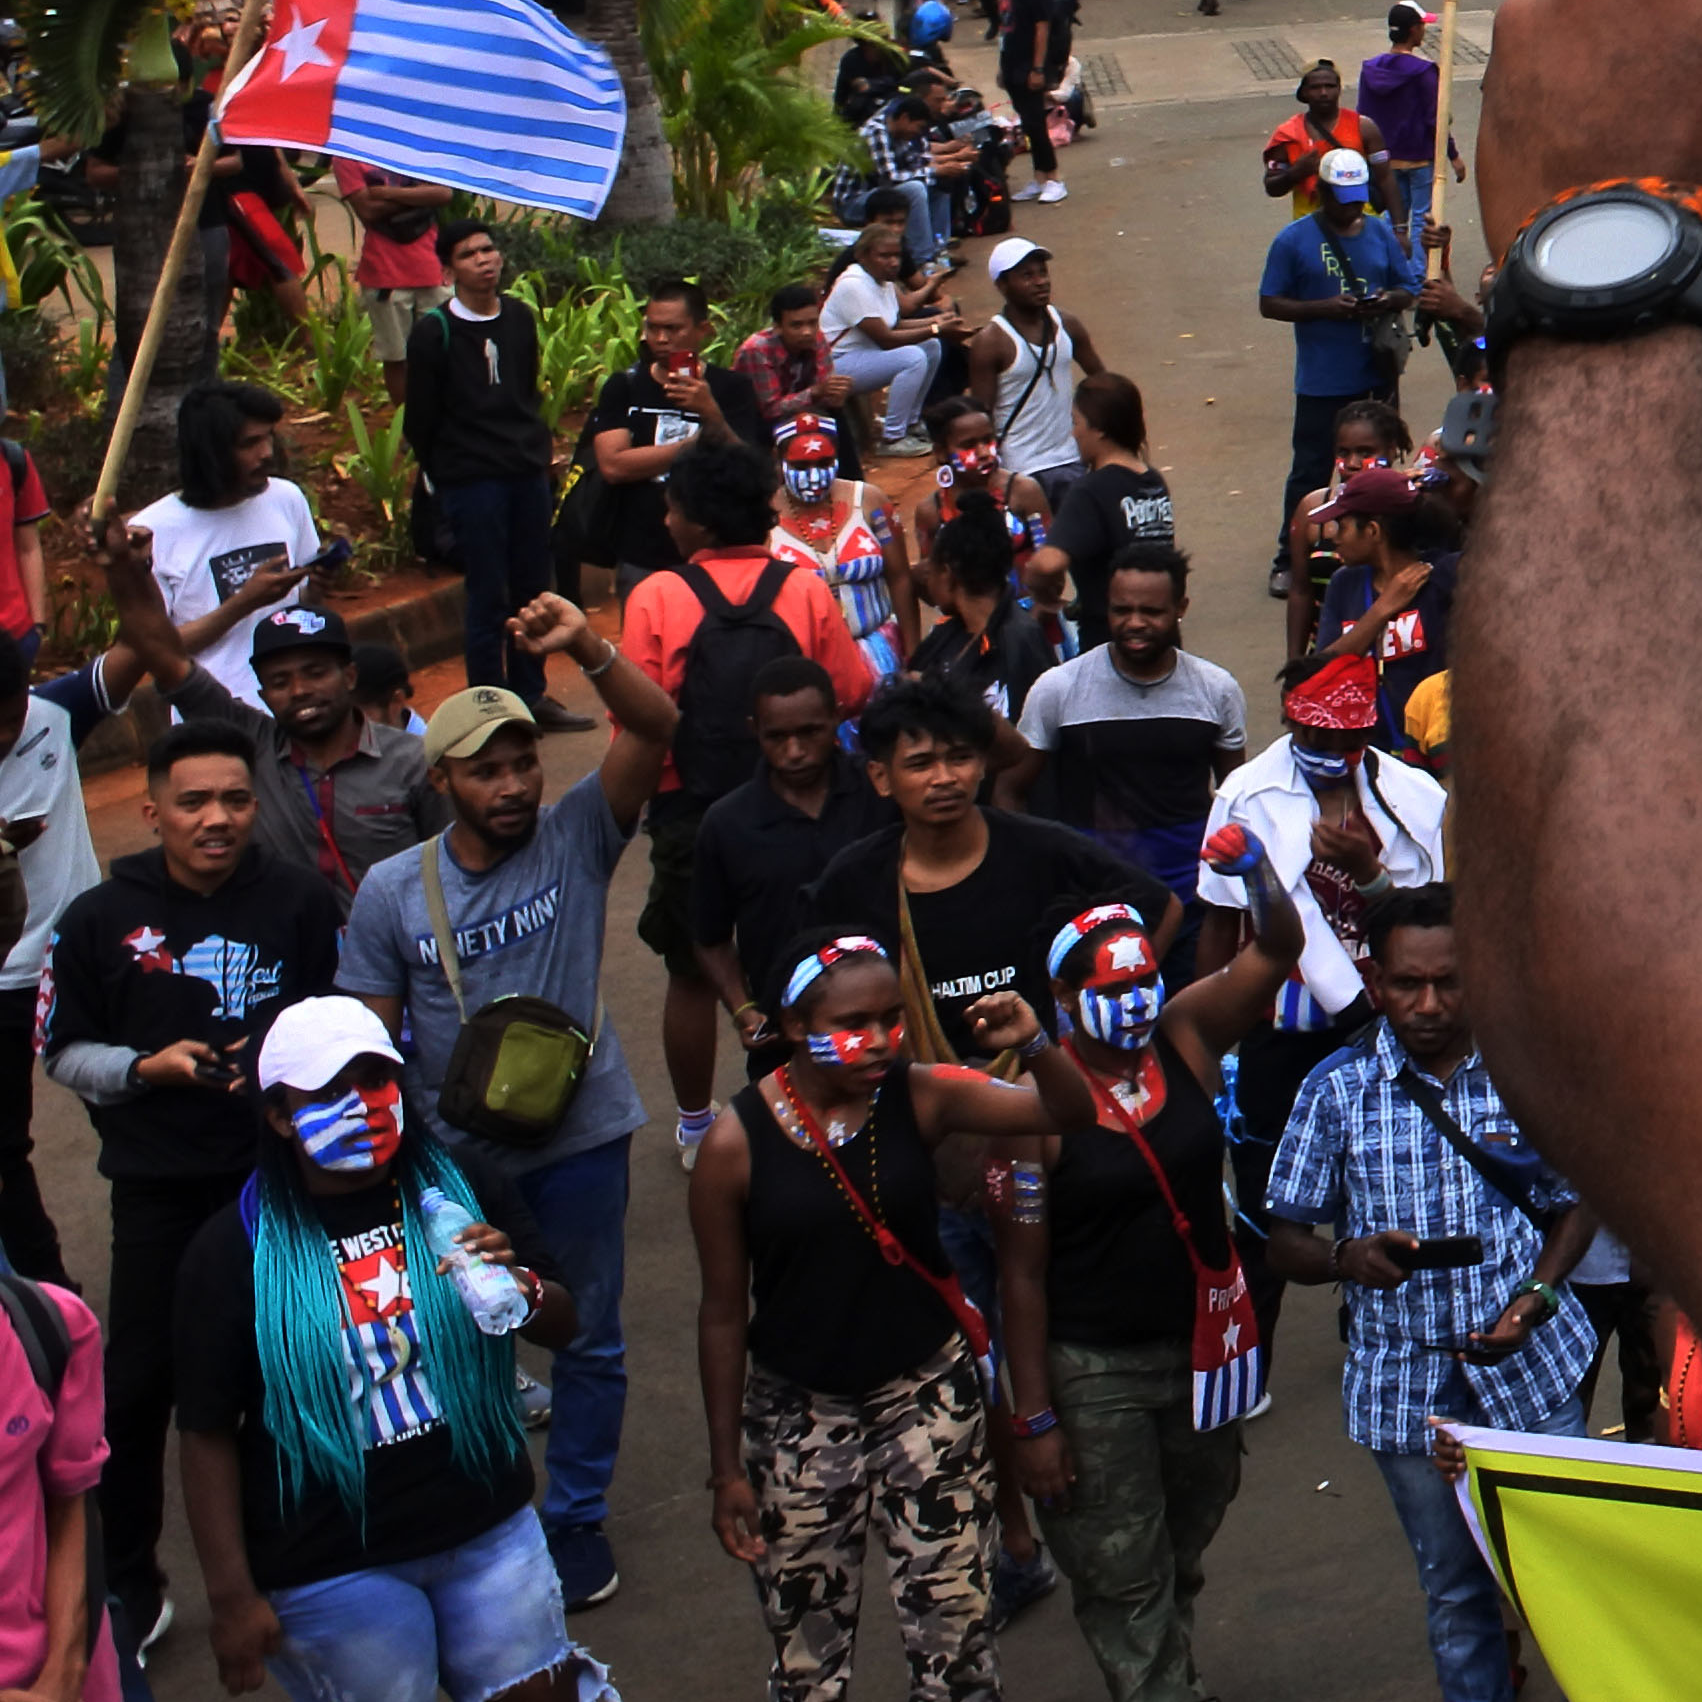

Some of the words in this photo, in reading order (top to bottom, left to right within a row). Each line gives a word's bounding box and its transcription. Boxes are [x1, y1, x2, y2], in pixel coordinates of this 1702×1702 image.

[418, 916, 508, 965] NNETY
[983, 965, 1016, 990] CUP
[341, 1224, 393, 1261] WEST
